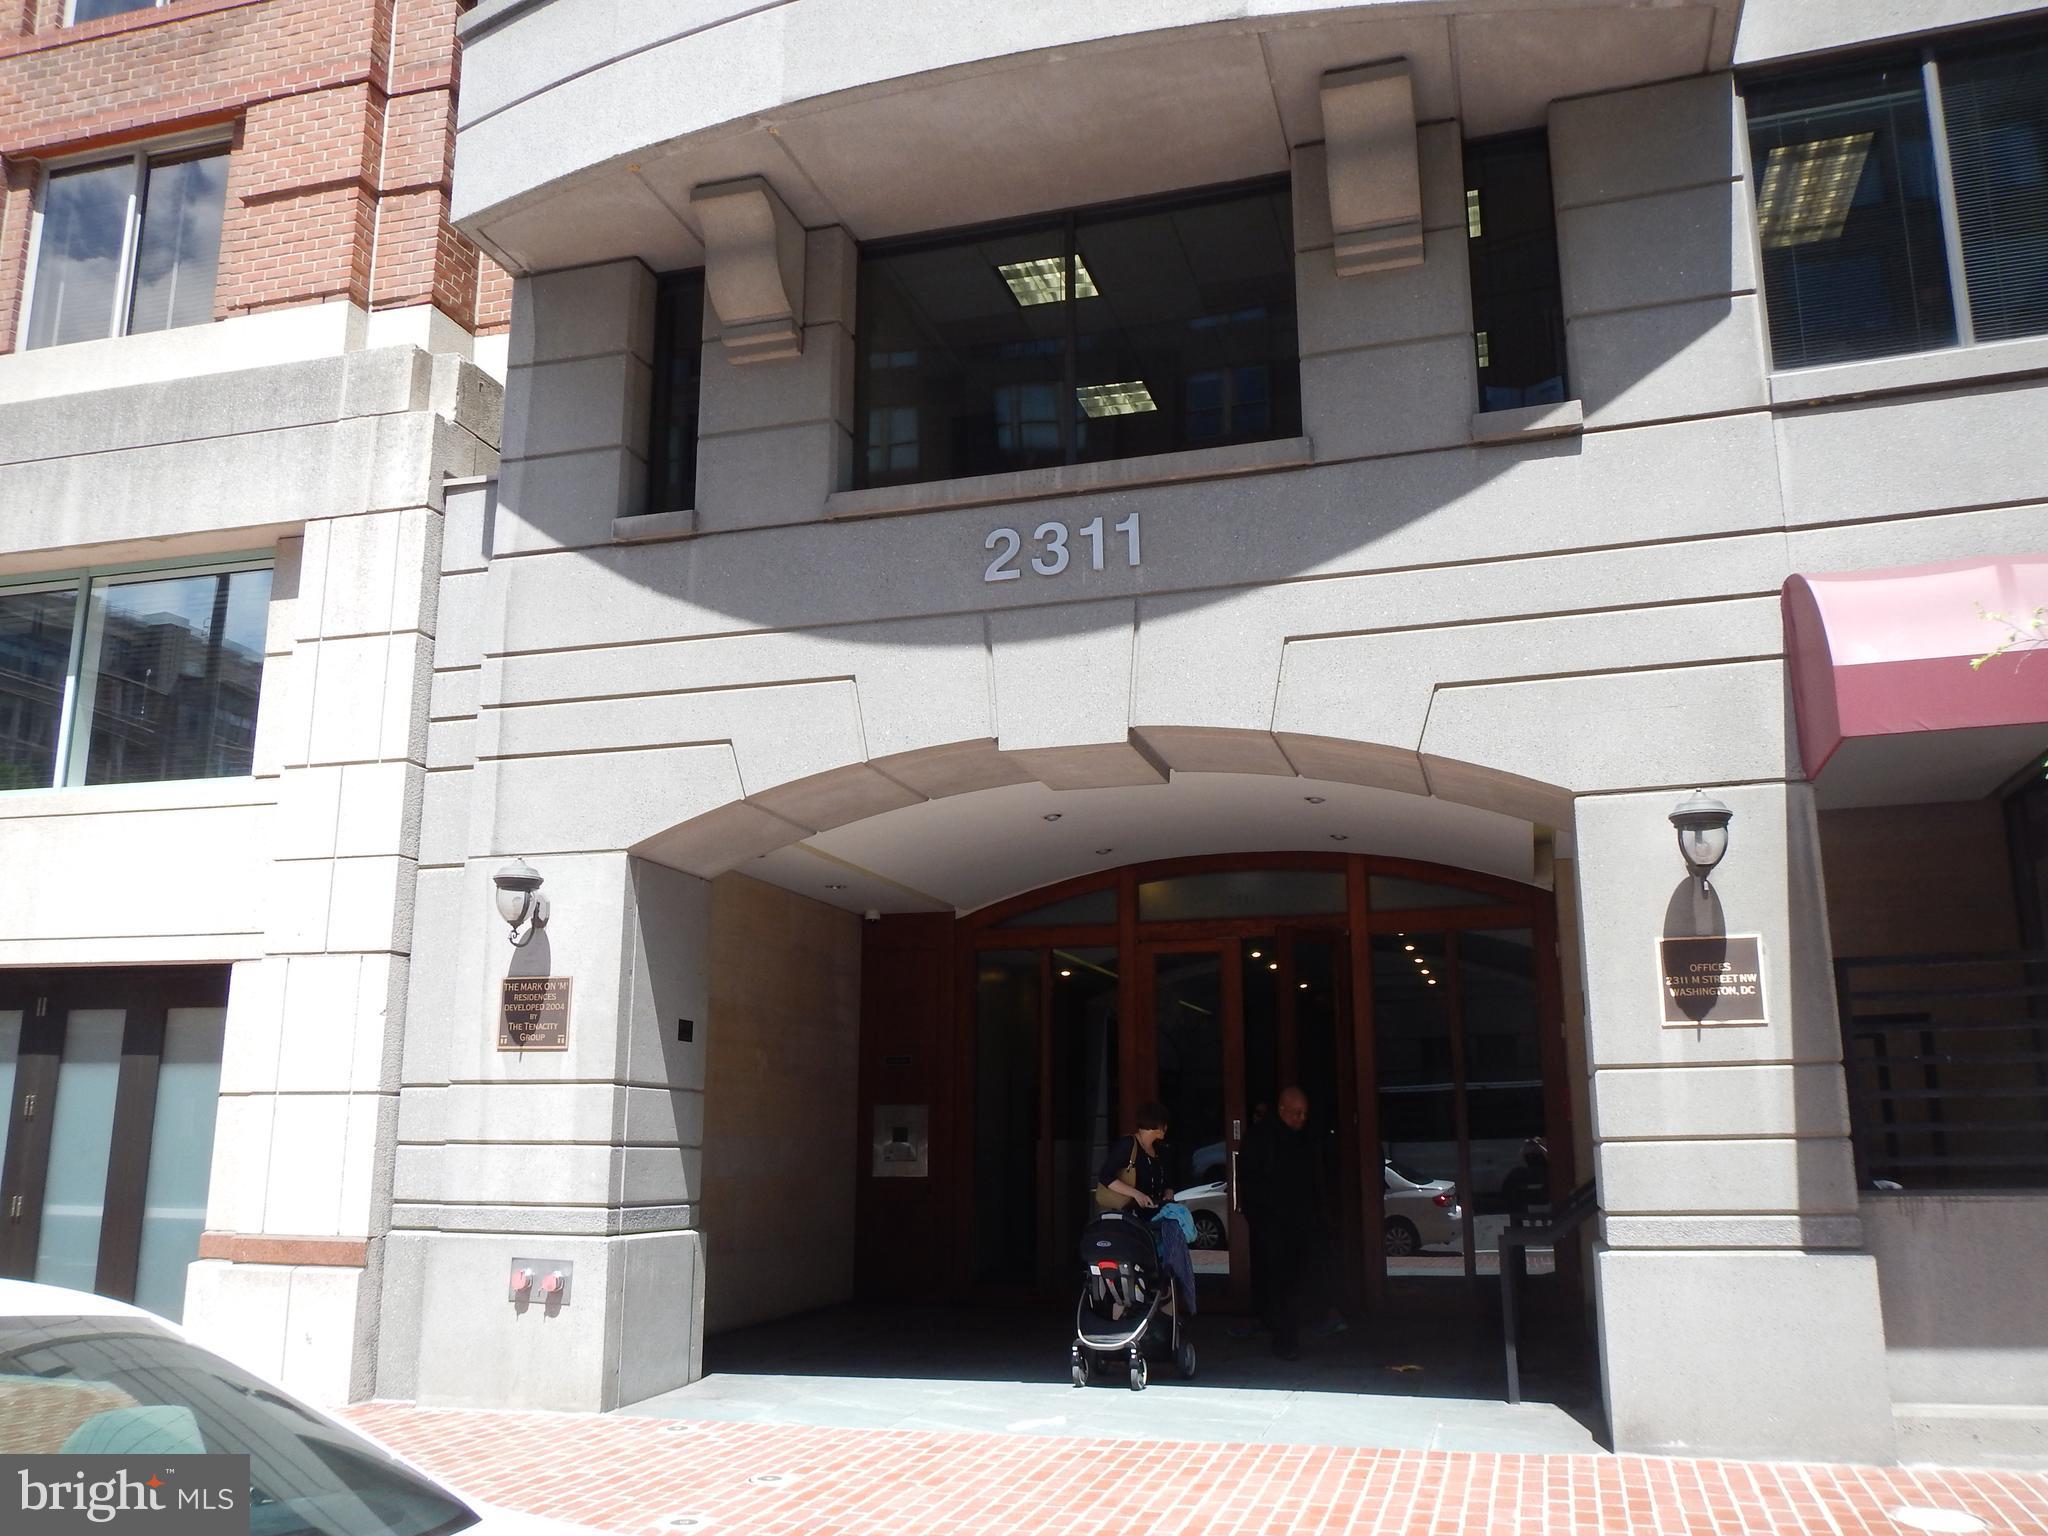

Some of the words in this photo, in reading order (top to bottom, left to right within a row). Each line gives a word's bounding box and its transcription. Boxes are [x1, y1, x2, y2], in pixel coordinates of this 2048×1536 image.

[984, 512, 1141, 582] 2311
[1689, 962, 1732, 972] OFFICES
[1665, 976, 1688, 986] 2311
[1691, 975, 1700, 984] M
[1702, 974, 1738, 984] STREET
[1739, 973, 1757, 983] NW
[504, 983, 519, 991] THE
[520, 982, 543, 991] MARK
[544, 982, 556, 991] ON
[1669, 986, 1739, 998] WASHINGTON,
[1740, 985, 1756, 995] DC
[513, 993, 557, 1001] RESIDENCES
[545, 1003, 565, 1011] 2004
[519, 1033, 546, 1042] GROUP
